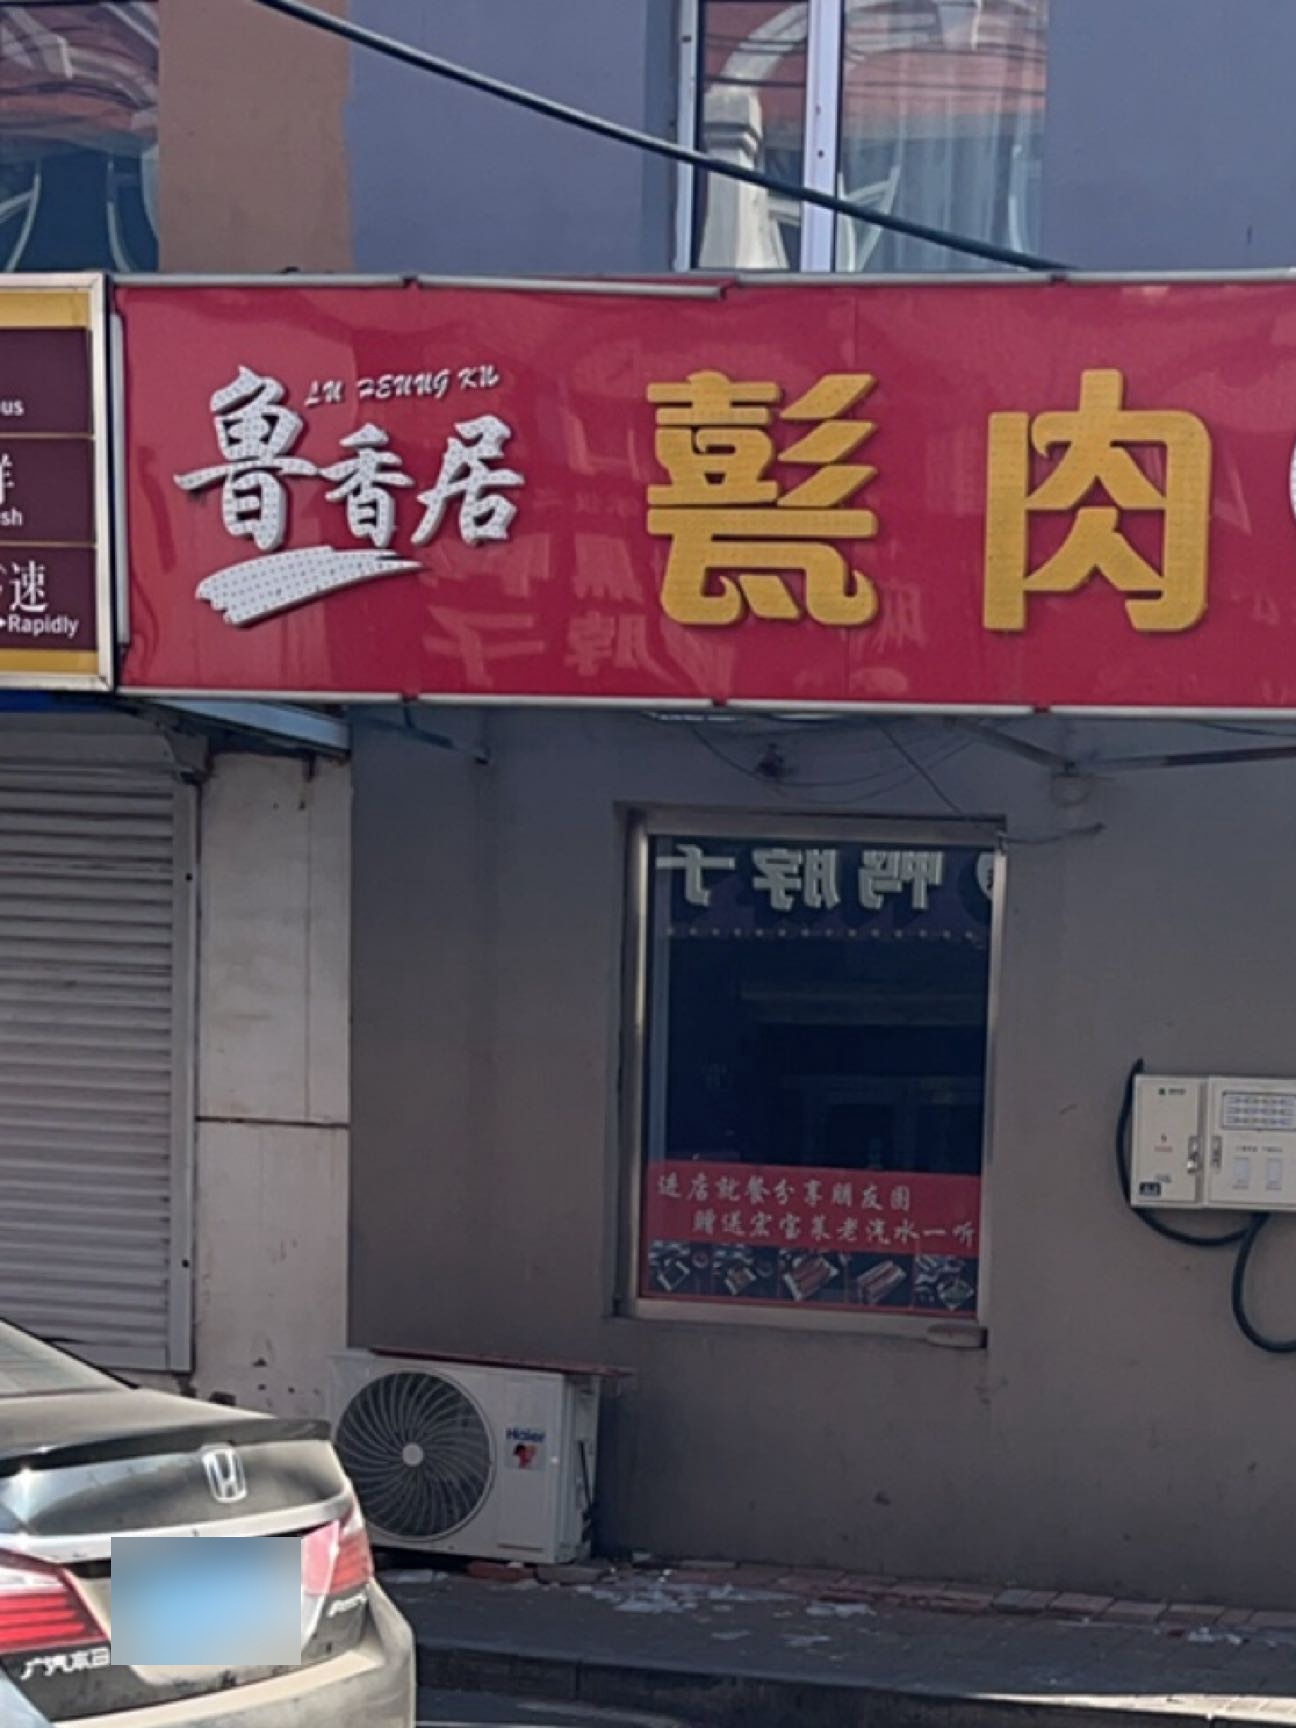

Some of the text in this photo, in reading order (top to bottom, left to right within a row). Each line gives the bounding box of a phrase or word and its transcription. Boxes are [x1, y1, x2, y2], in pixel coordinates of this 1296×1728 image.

[173, 365, 526, 552] 鲁香居
[7, 613, 80, 640] Rapidly
